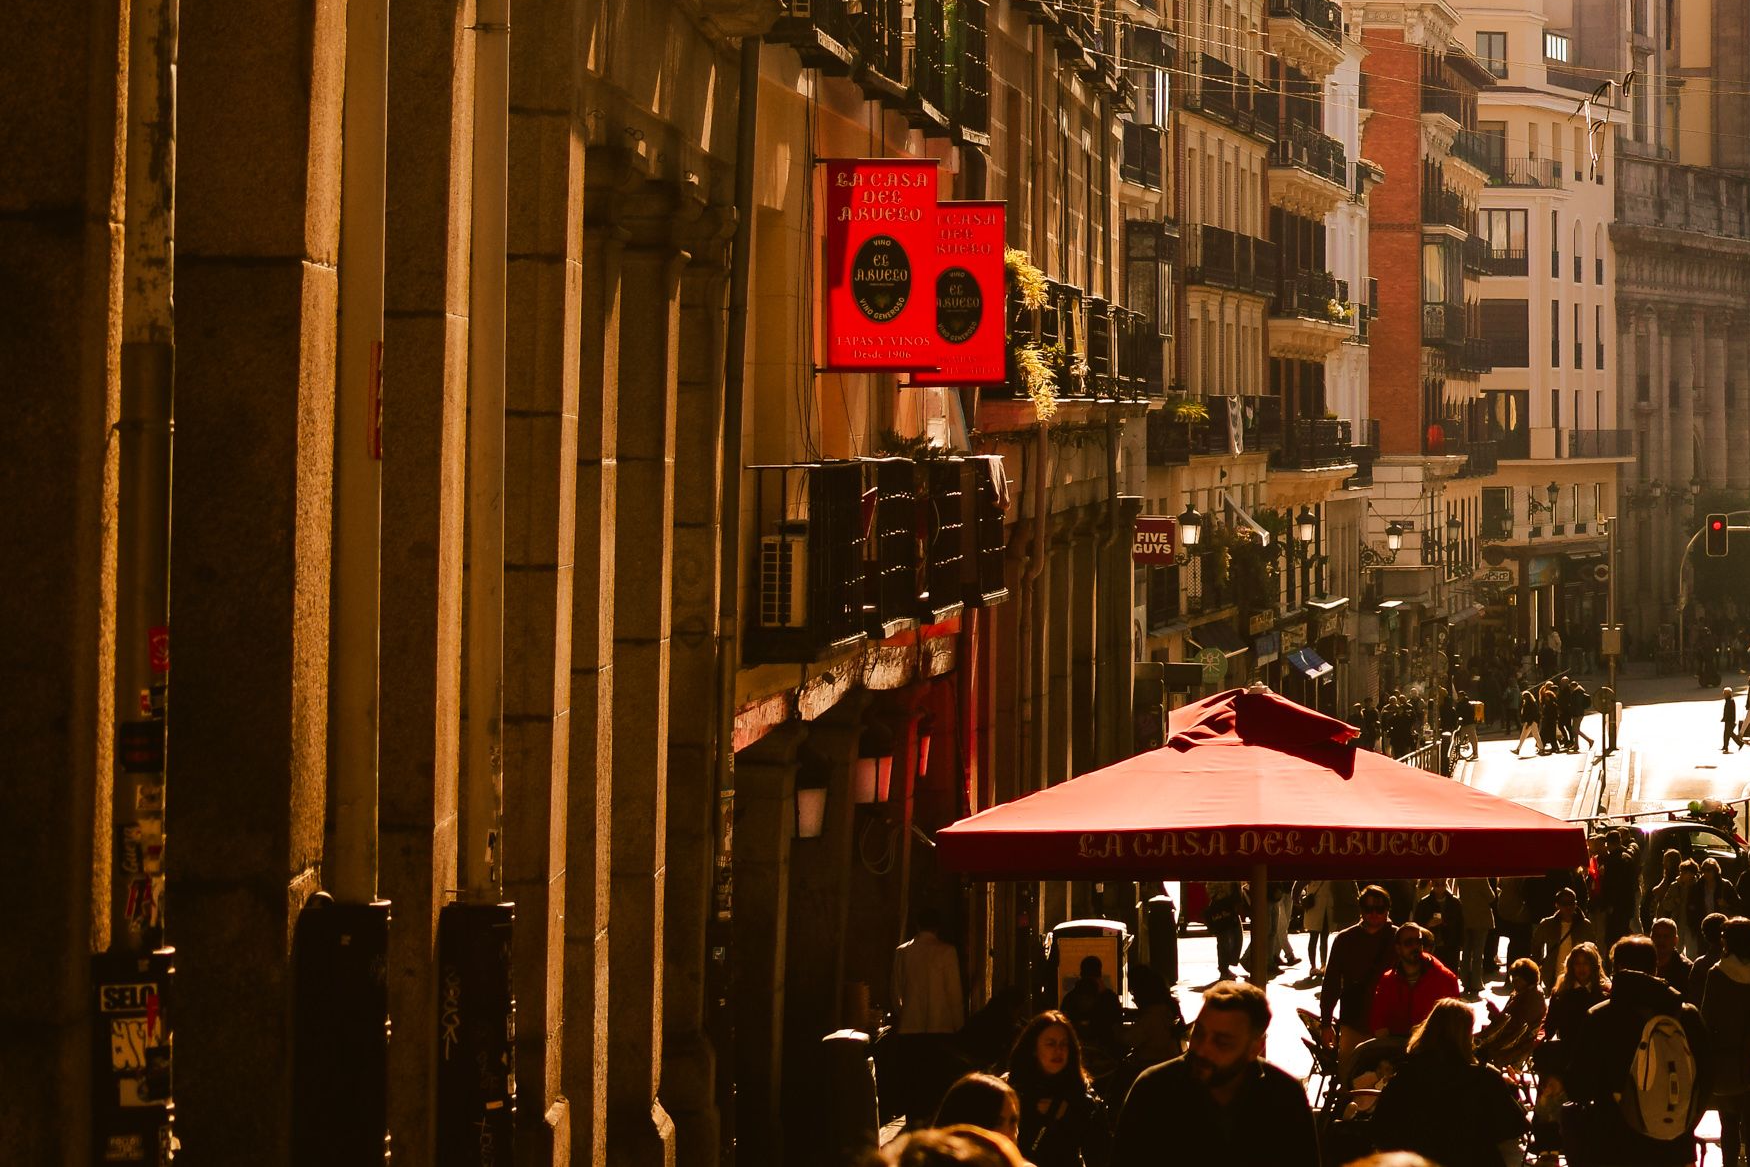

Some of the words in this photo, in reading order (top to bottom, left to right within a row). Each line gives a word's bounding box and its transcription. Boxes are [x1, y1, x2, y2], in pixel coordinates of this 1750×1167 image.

[835, 172, 863, 187] LA
[870, 172, 928, 187] CASA
[862, 189, 903, 204] DEL
[837, 206, 922, 222] ABUELO
[873, 239, 892, 247] VINO
[937, 243, 991, 255] BUELO
[873, 254, 889, 267] EL
[854, 268, 908, 282] ABUELO
[860, 297, 874, 315] VINO
[873, 296, 905, 320] GENEROSO
[837, 336, 874, 346] TAPAS
[877, 336, 887, 346] Y
[890, 336, 930, 346] VINOS
[854, 350, 882, 359] Desde
[888, 350, 911, 359] 1906
[1136, 532, 1168, 543] FIVE
[1133, 543, 1172, 554] GUYS
[1078, 833, 1124, 858] LA
[1132, 831, 1228, 858] CASA
[1236, 830, 1304, 856] DEL
[1311, 830, 1452, 856] ABUELO
